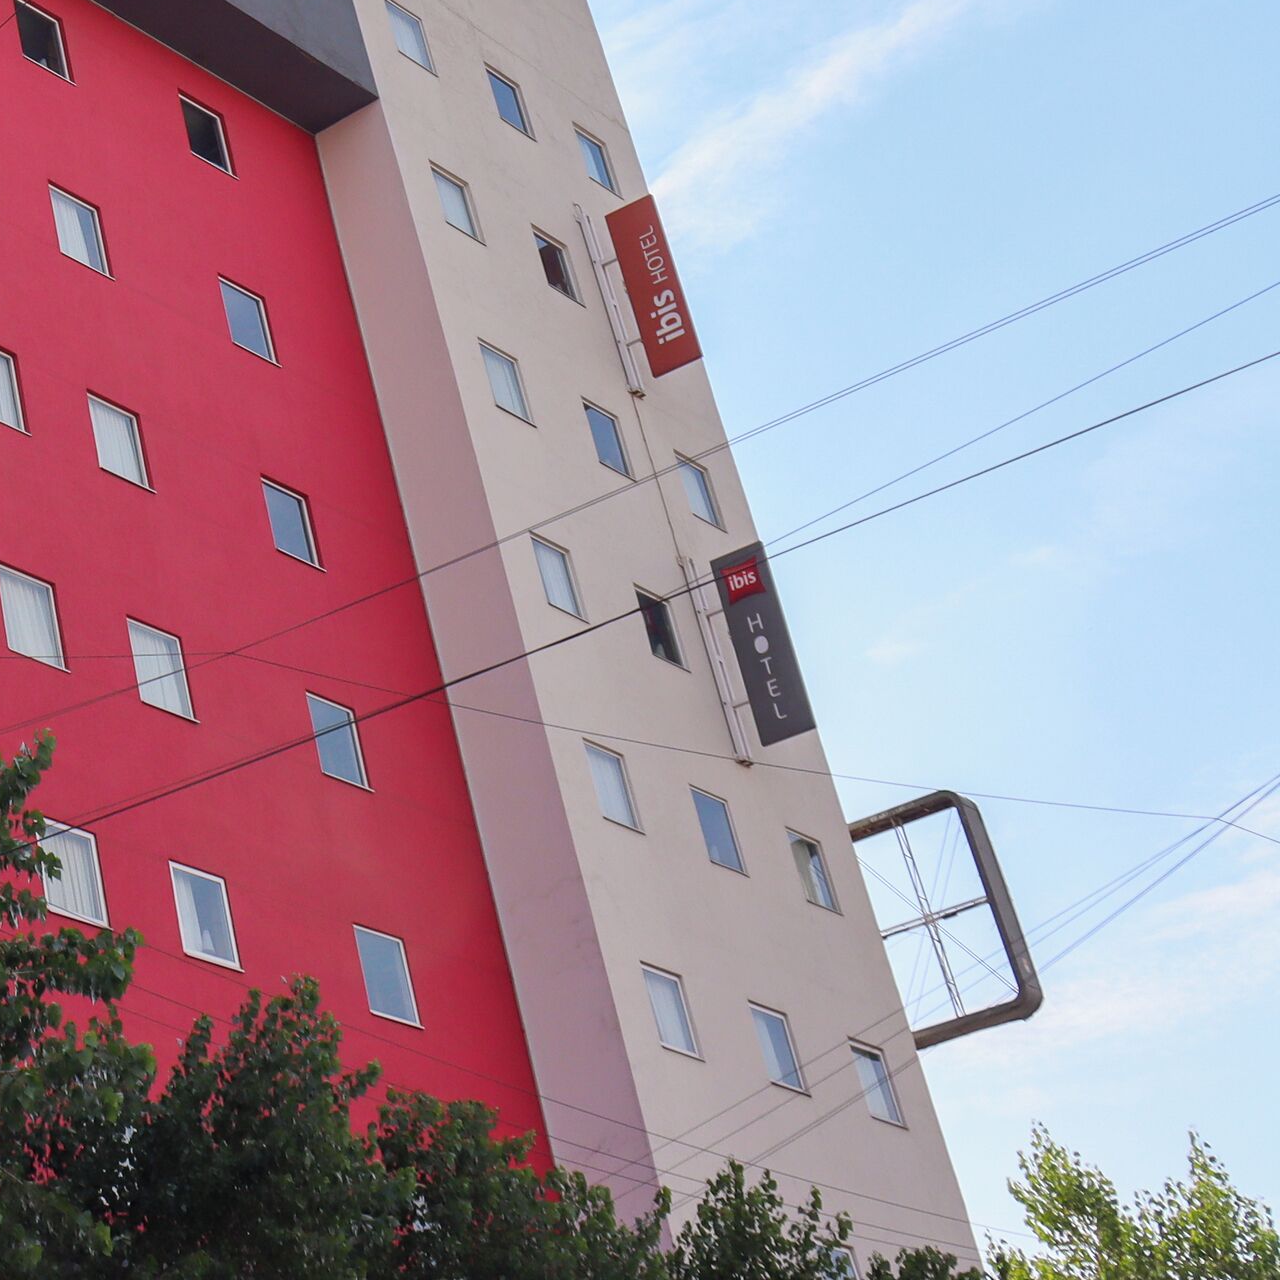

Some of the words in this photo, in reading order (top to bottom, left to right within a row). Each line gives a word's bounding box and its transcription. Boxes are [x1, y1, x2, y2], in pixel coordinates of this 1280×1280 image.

[639, 224, 669, 285] HOTEL
[651, 288, 686, 345] ibis
[728, 568, 757, 592] ibis
[746, 613, 788, 720] HOTEL
